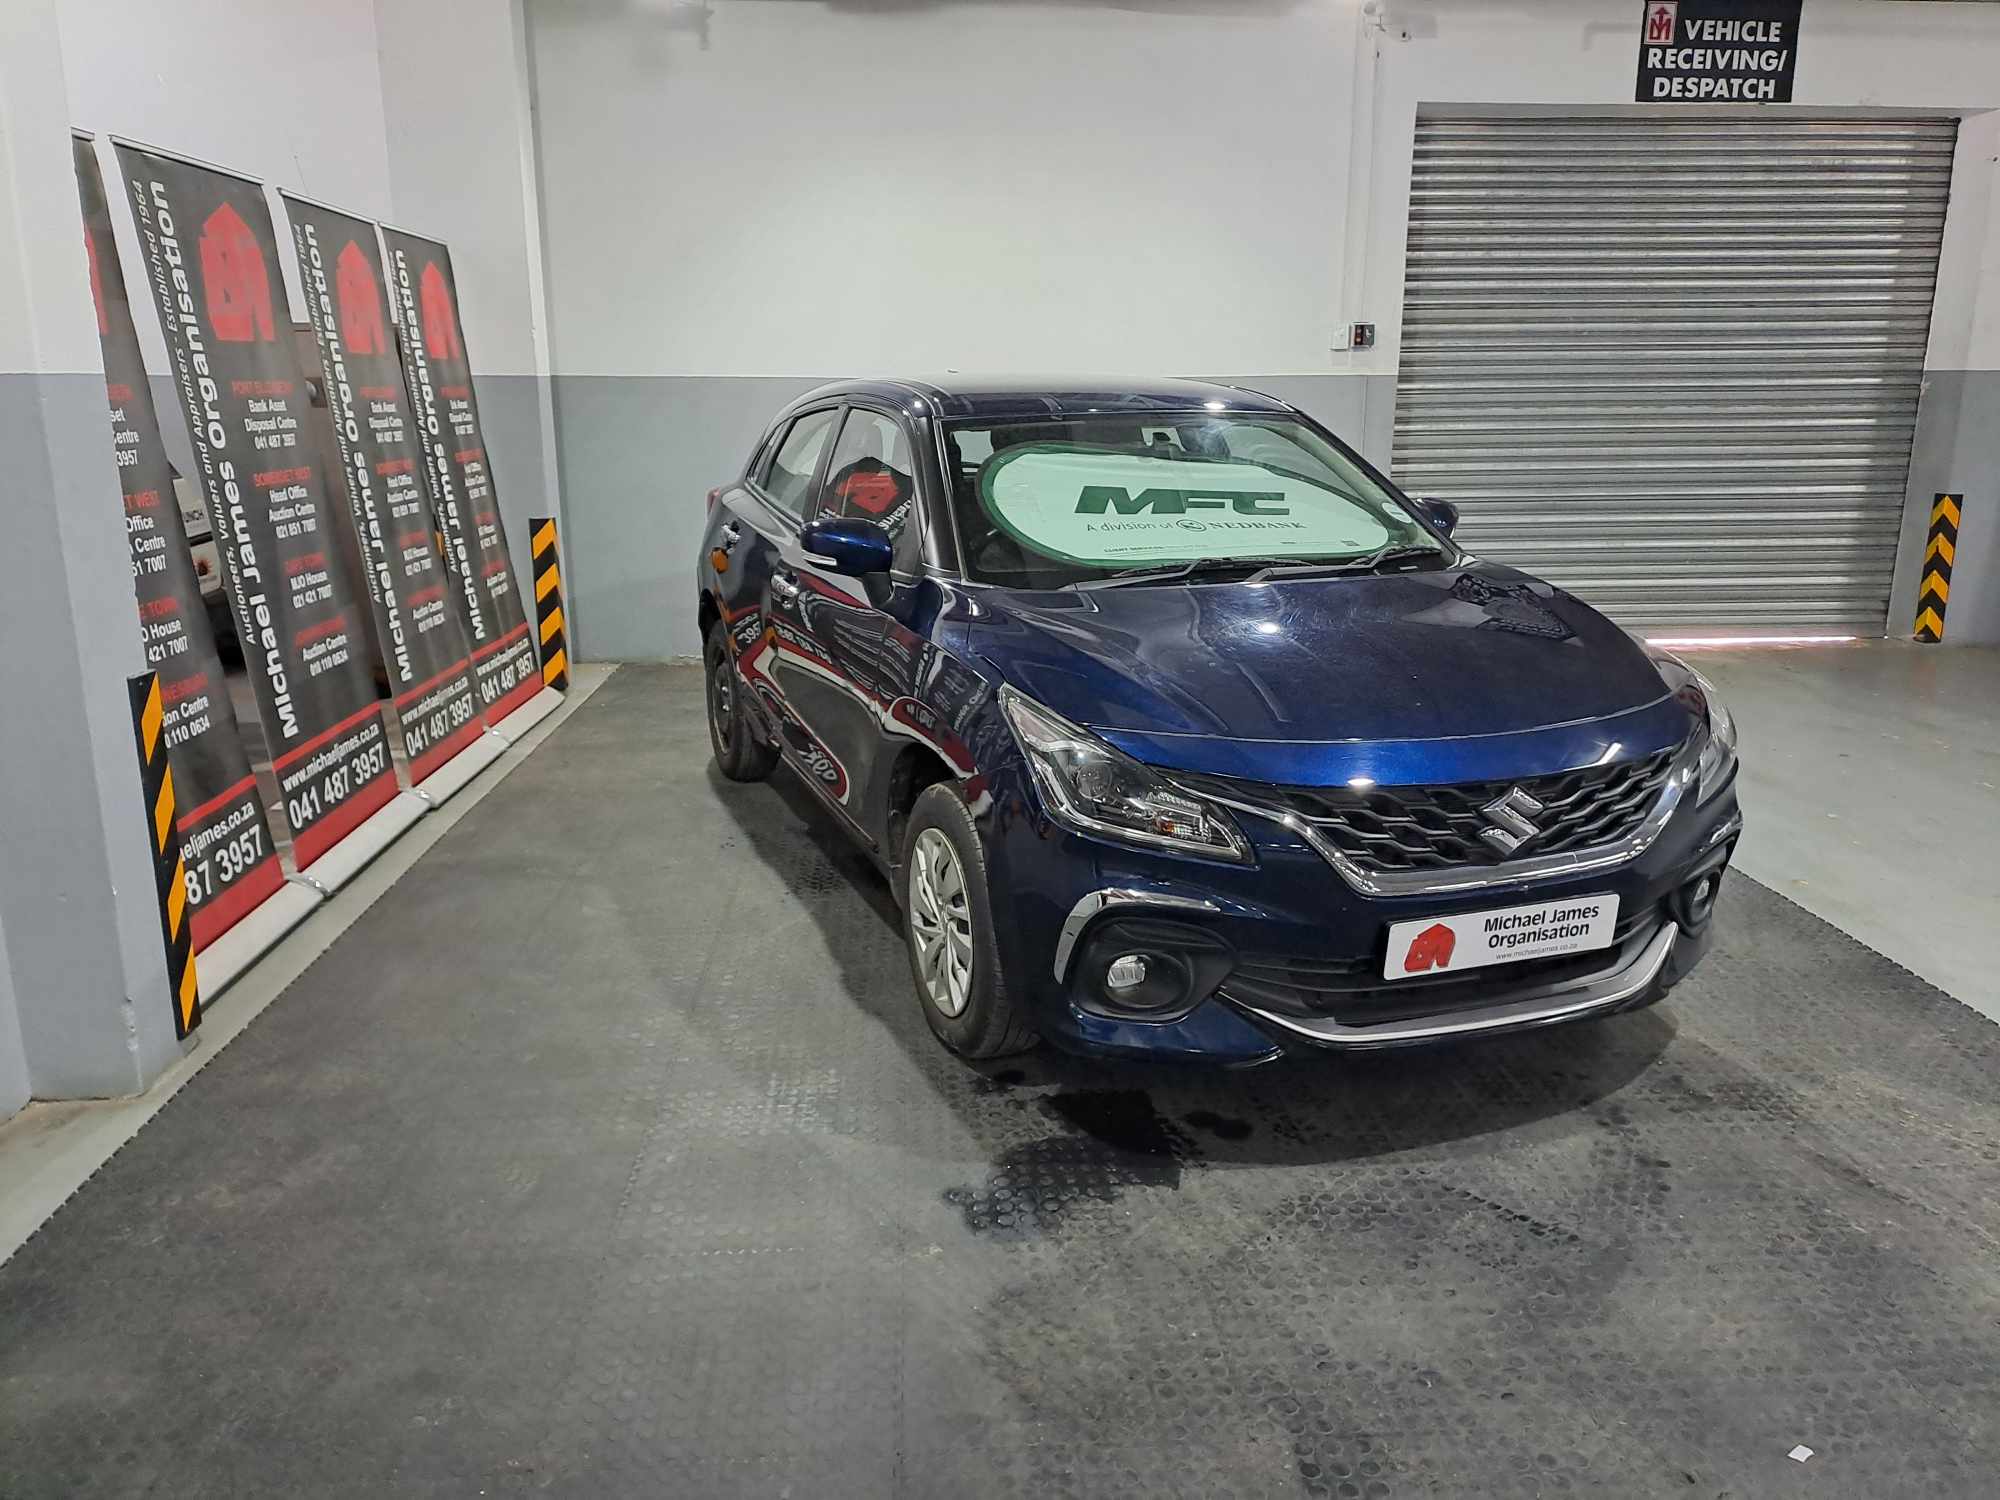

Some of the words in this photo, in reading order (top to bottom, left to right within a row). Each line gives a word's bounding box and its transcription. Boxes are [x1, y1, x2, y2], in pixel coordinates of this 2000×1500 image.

[1685, 20, 1782, 43] VEHICLE
[1647, 48, 1788, 72] RECEIVING/
[1653, 77, 1776, 99] DESPATCH
[132, 179, 151, 225] 1964
[144, 229, 178, 332] Established
[150, 181, 226, 449] Organisation
[304, 224, 359, 442] Organisation
[395, 250, 439, 435] Organisation
[176, 348, 204, 438] Appraisers
[322, 358, 343, 434] Appraisers
[113, 430, 140, 445] entre
[337, 435, 349, 462] and
[419, 430, 431, 453] and
[116, 449, 138, 467] 3957
[196, 442, 213, 474] and
[353, 451, 384, 553] James
[434, 443, 460, 530] James
[1074, 485, 1290, 515] MFC
[208, 479, 229, 540] Valuers
[219, 461, 261, 583] James
[1087, 523, 1097, 532] A
[1101, 521, 1157, 532] division
[1209, 521, 1307, 529] NEDBANK
[135, 536, 166, 553] Centre
[131, 558, 144, 577] 51
[144, 554, 166, 573] 7007
[226, 547, 256, 644] Auctioneers,
[452, 538, 486, 640] Michael
[150, 619, 181, 638] House
[375, 562, 413, 682] Michael
[148, 642, 166, 663] 421
[167, 636, 188, 656] 7007
[249, 594, 299, 738] Michael
[480, 675, 501, 703] 041
[500, 665, 516, 690] 487
[181, 695, 209, 718] Centre
[405, 722, 429, 757] 041
[430, 709, 450, 739] 487
[449, 692, 473, 726] 3957
[171, 722, 189, 744] 110
[190, 715, 210, 734] 0634
[288, 785, 321, 830] 041
[324, 765, 350, 804] 487
[351, 741, 385, 785] 3957
[215, 824, 262, 882] 3957
[1484, 910, 1546, 933] Michael
[1549, 905, 1600, 924] James
[1488, 923, 1590, 949] Organisation
